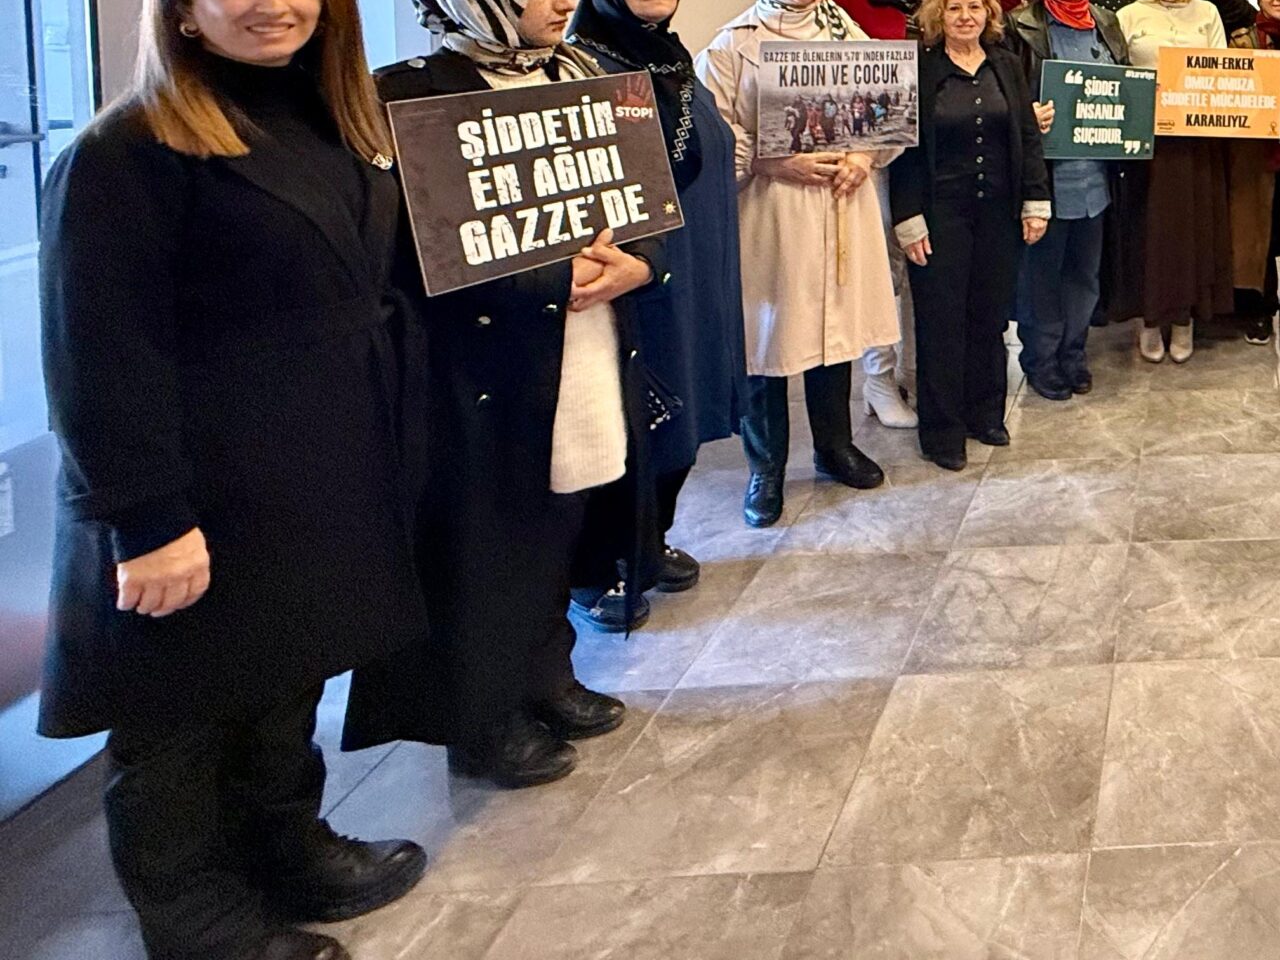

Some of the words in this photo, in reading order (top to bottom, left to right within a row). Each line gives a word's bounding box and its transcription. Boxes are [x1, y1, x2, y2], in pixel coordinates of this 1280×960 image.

[803, 49, 842, 62] ÖLENLERİN
[886, 50, 915, 61] FAZLASI
[1186, 56, 1254, 71] KADIN-ERKEK
[779, 64, 826, 88] KADIN
[830, 64, 849, 86] VE
[853, 63, 899, 90] ÇOCUK
[615, 105, 653, 120] STOP!
[1075, 99, 1125, 121] İNSANLIK
[1186, 114, 1251, 129] KARARLIYIZ.
[457, 95, 618, 167] ŞİDDETİN
[467, 164, 523, 211] EN
[533, 144, 625, 198] AĞIRI
